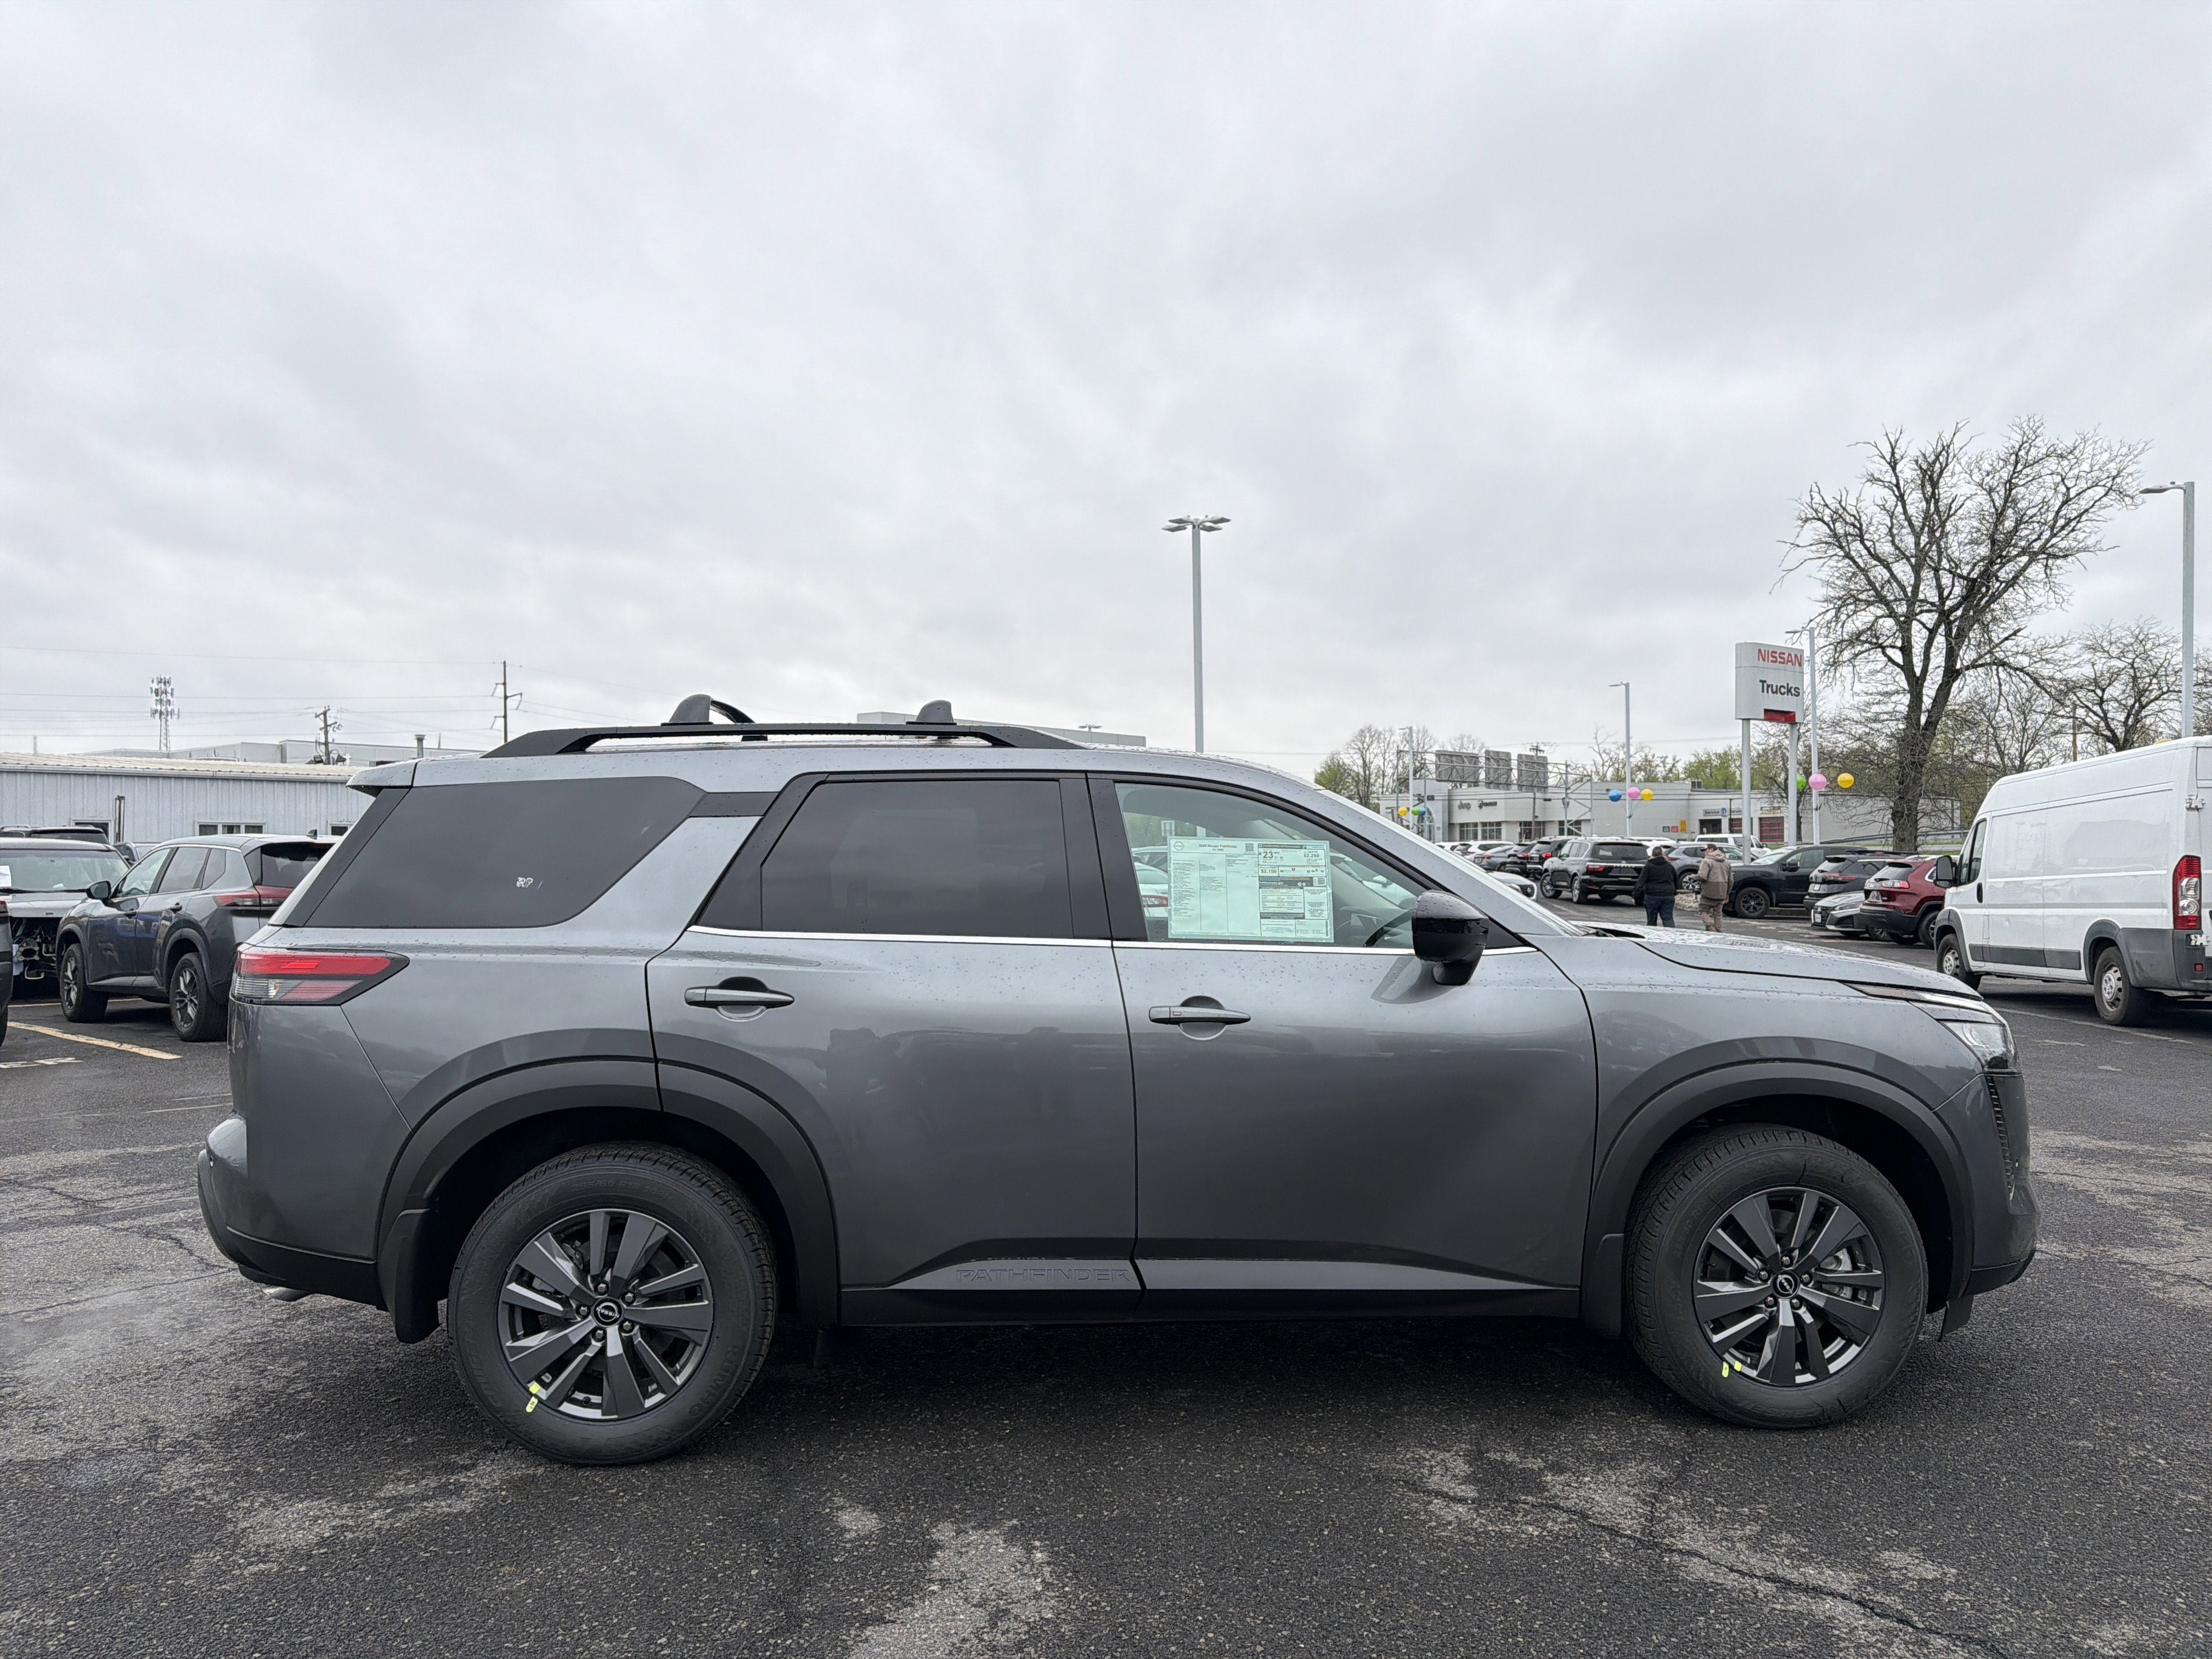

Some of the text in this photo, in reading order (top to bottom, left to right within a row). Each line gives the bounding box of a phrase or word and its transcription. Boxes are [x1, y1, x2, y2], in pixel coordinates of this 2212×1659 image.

[1757, 648, 1802, 667] NISSAN
[1759, 679, 1801, 697] Trucks
[956, 1268, 1130, 1282] PATHFINDER
[596, 1306, 620, 1318] NISSAN
